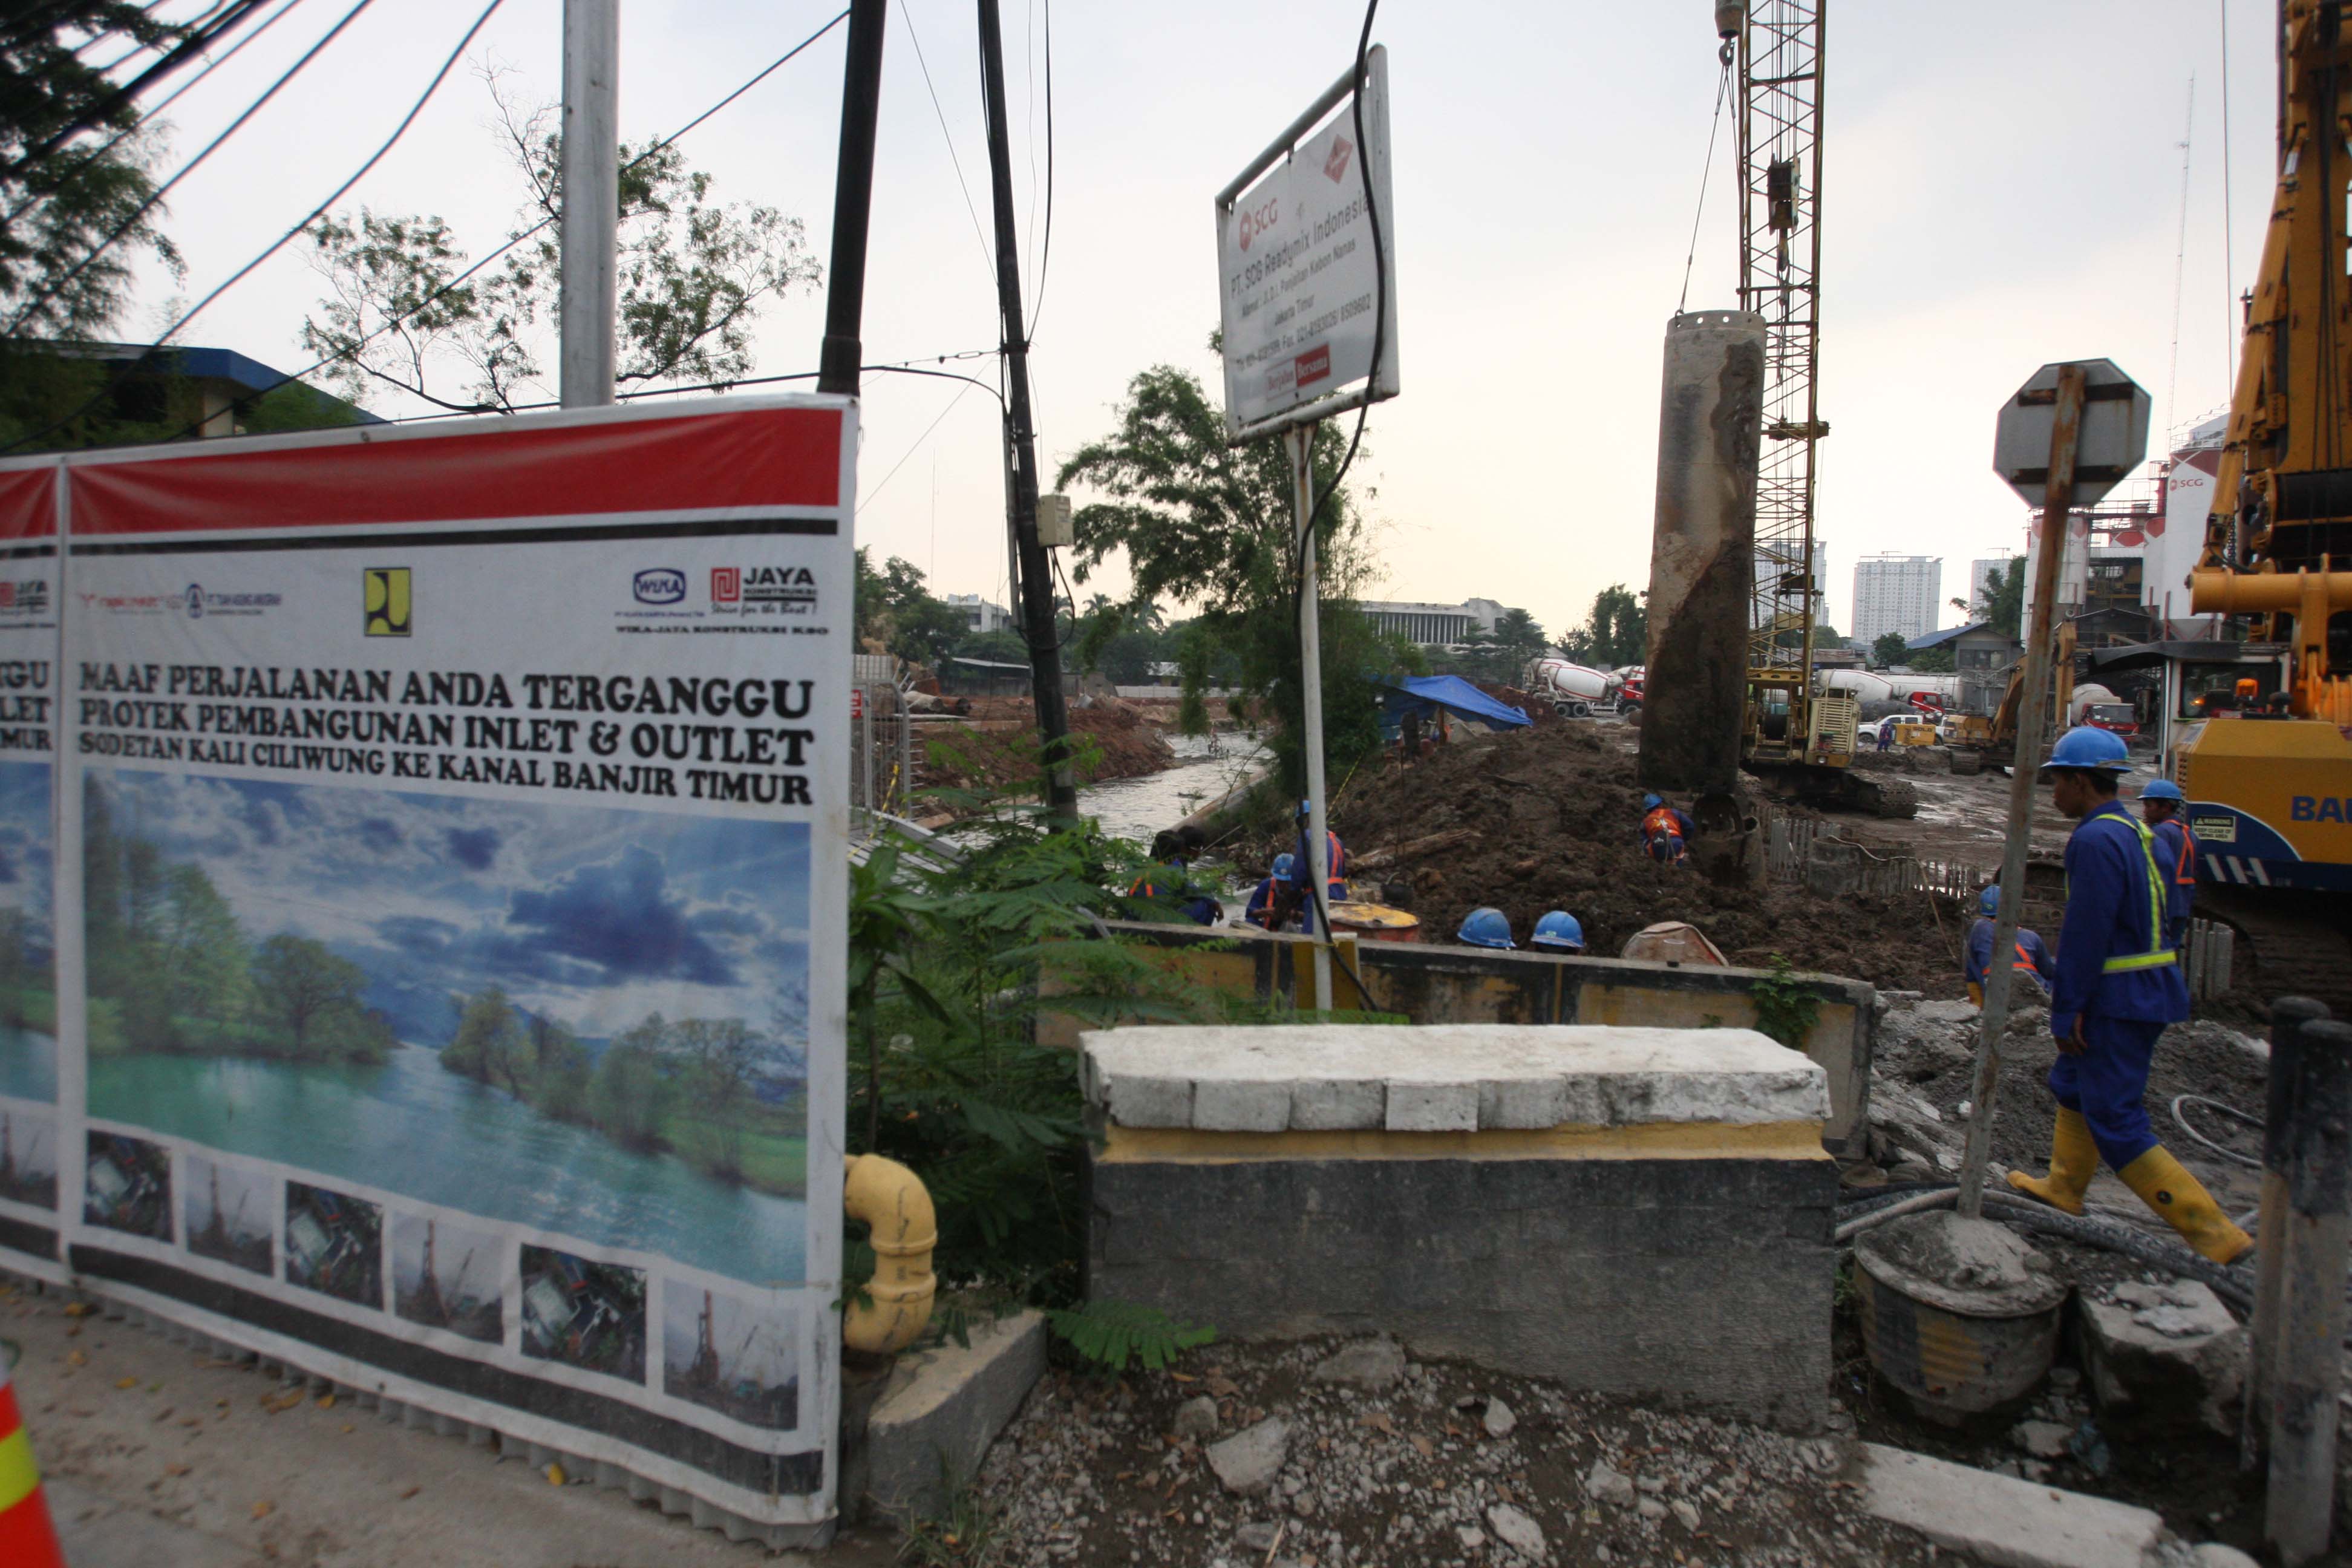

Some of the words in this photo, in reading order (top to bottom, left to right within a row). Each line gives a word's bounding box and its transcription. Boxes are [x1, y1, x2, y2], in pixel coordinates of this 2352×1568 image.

[1255, 198, 1277, 235] SCG
[1246, 260, 1263, 289] SCG
[1266, 229, 1310, 272] Readymix
[1314, 191, 1368, 244] Indonesia
[2180, 479, 2203, 488] SCG
[638, 579, 681, 595] WIKA
[743, 567, 815, 585] JAYA
[79, 663, 160, 694] MAAF
[168, 665, 390, 704] PERJALANAN
[400, 670, 513, 708] ANDA
[523, 673, 814, 719] TERGANGGU
[79, 697, 192, 731] PROYEK
[197, 703, 455, 748] PEMBANGUNAN
[464, 716, 579, 753] INLET
[588, 721, 619, 756] &
[631, 722, 814, 766] OUTLET
[79, 731, 183, 759] SODETAN
[189, 738, 246, 765] KALI
[252, 743, 385, 775] CILIWUNG
[392, 753, 430, 778] KE
[437, 754, 544, 787] KANAL
[554, 762, 678, 797] BANJIR
[686, 770, 812, 805] TIMUR
